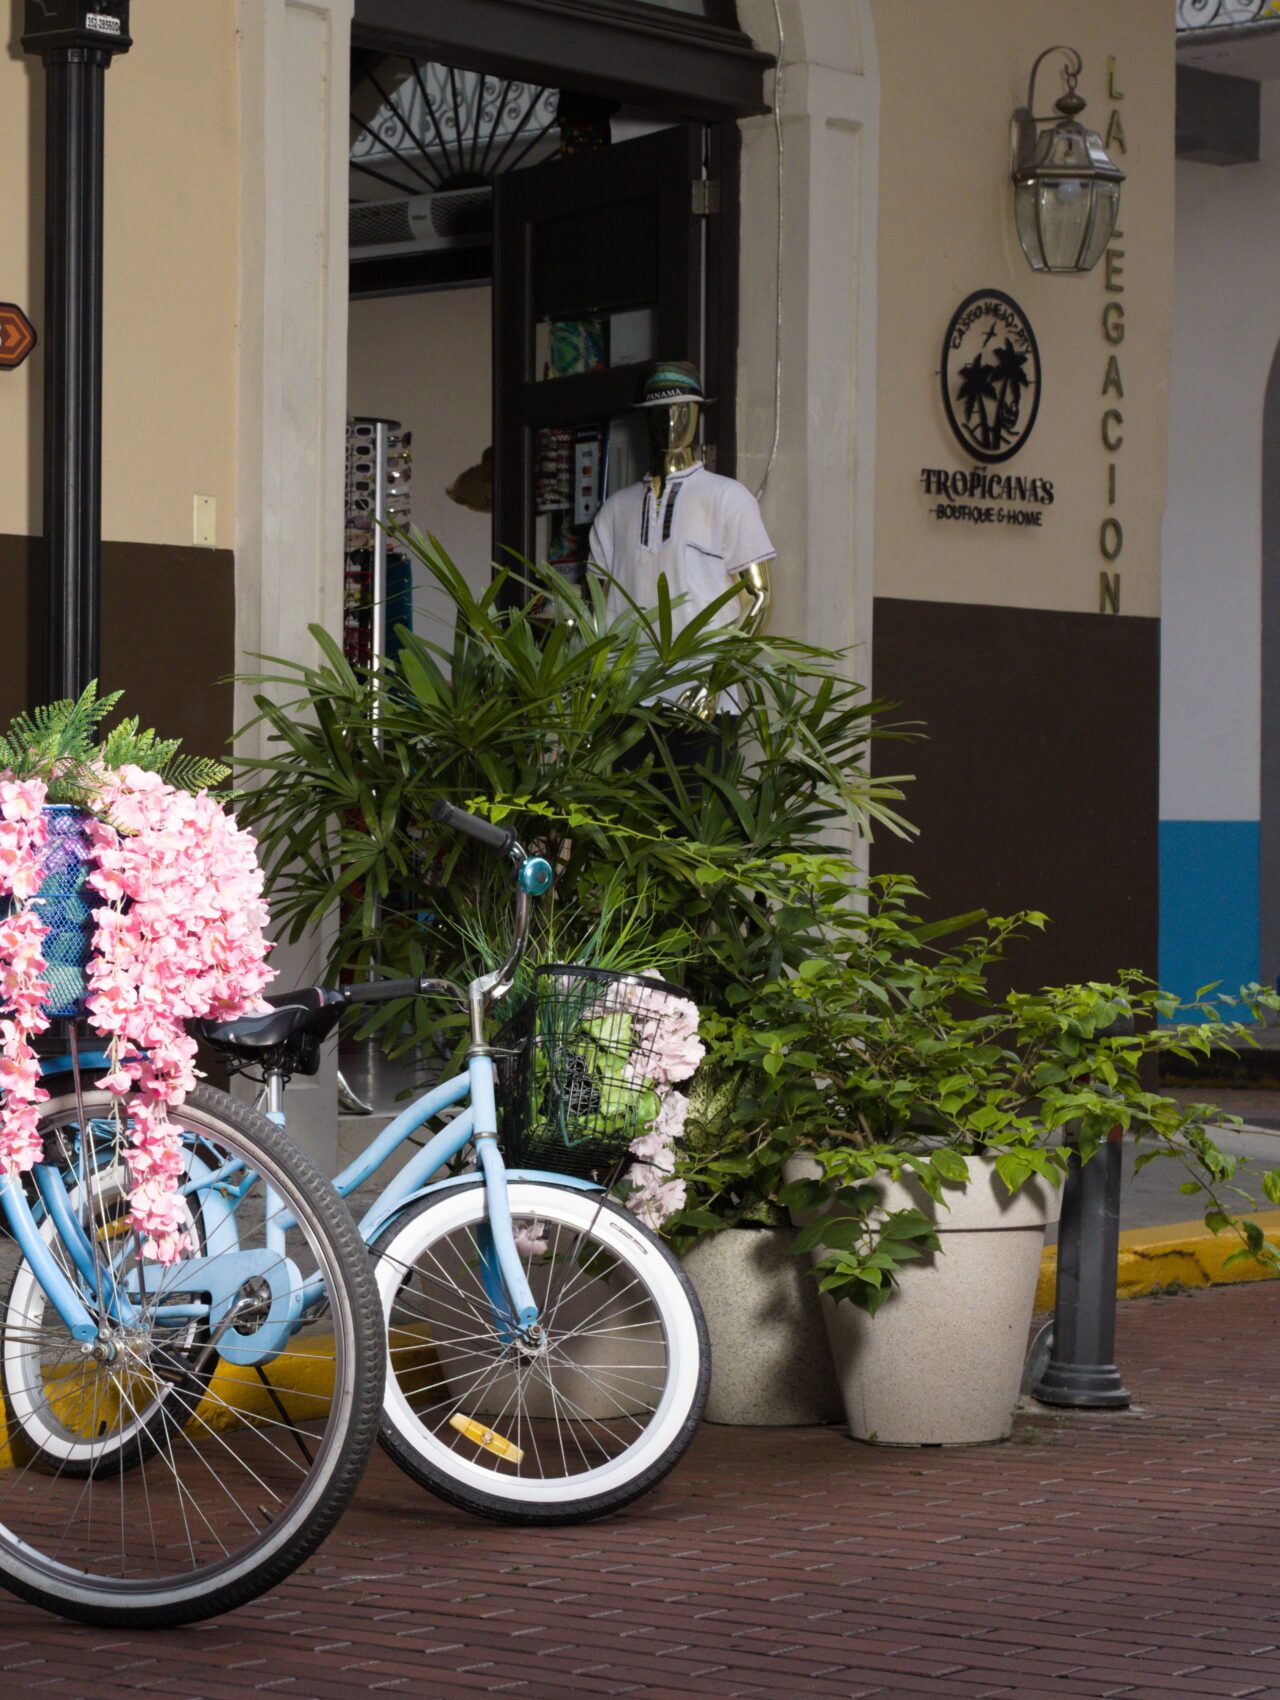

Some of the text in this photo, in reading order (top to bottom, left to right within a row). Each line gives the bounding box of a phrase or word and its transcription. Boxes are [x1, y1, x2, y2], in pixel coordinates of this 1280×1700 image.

[646, 388, 682, 401] PANAMA
[936, 504, 1043, 526] BOUTIQUE & HOME
